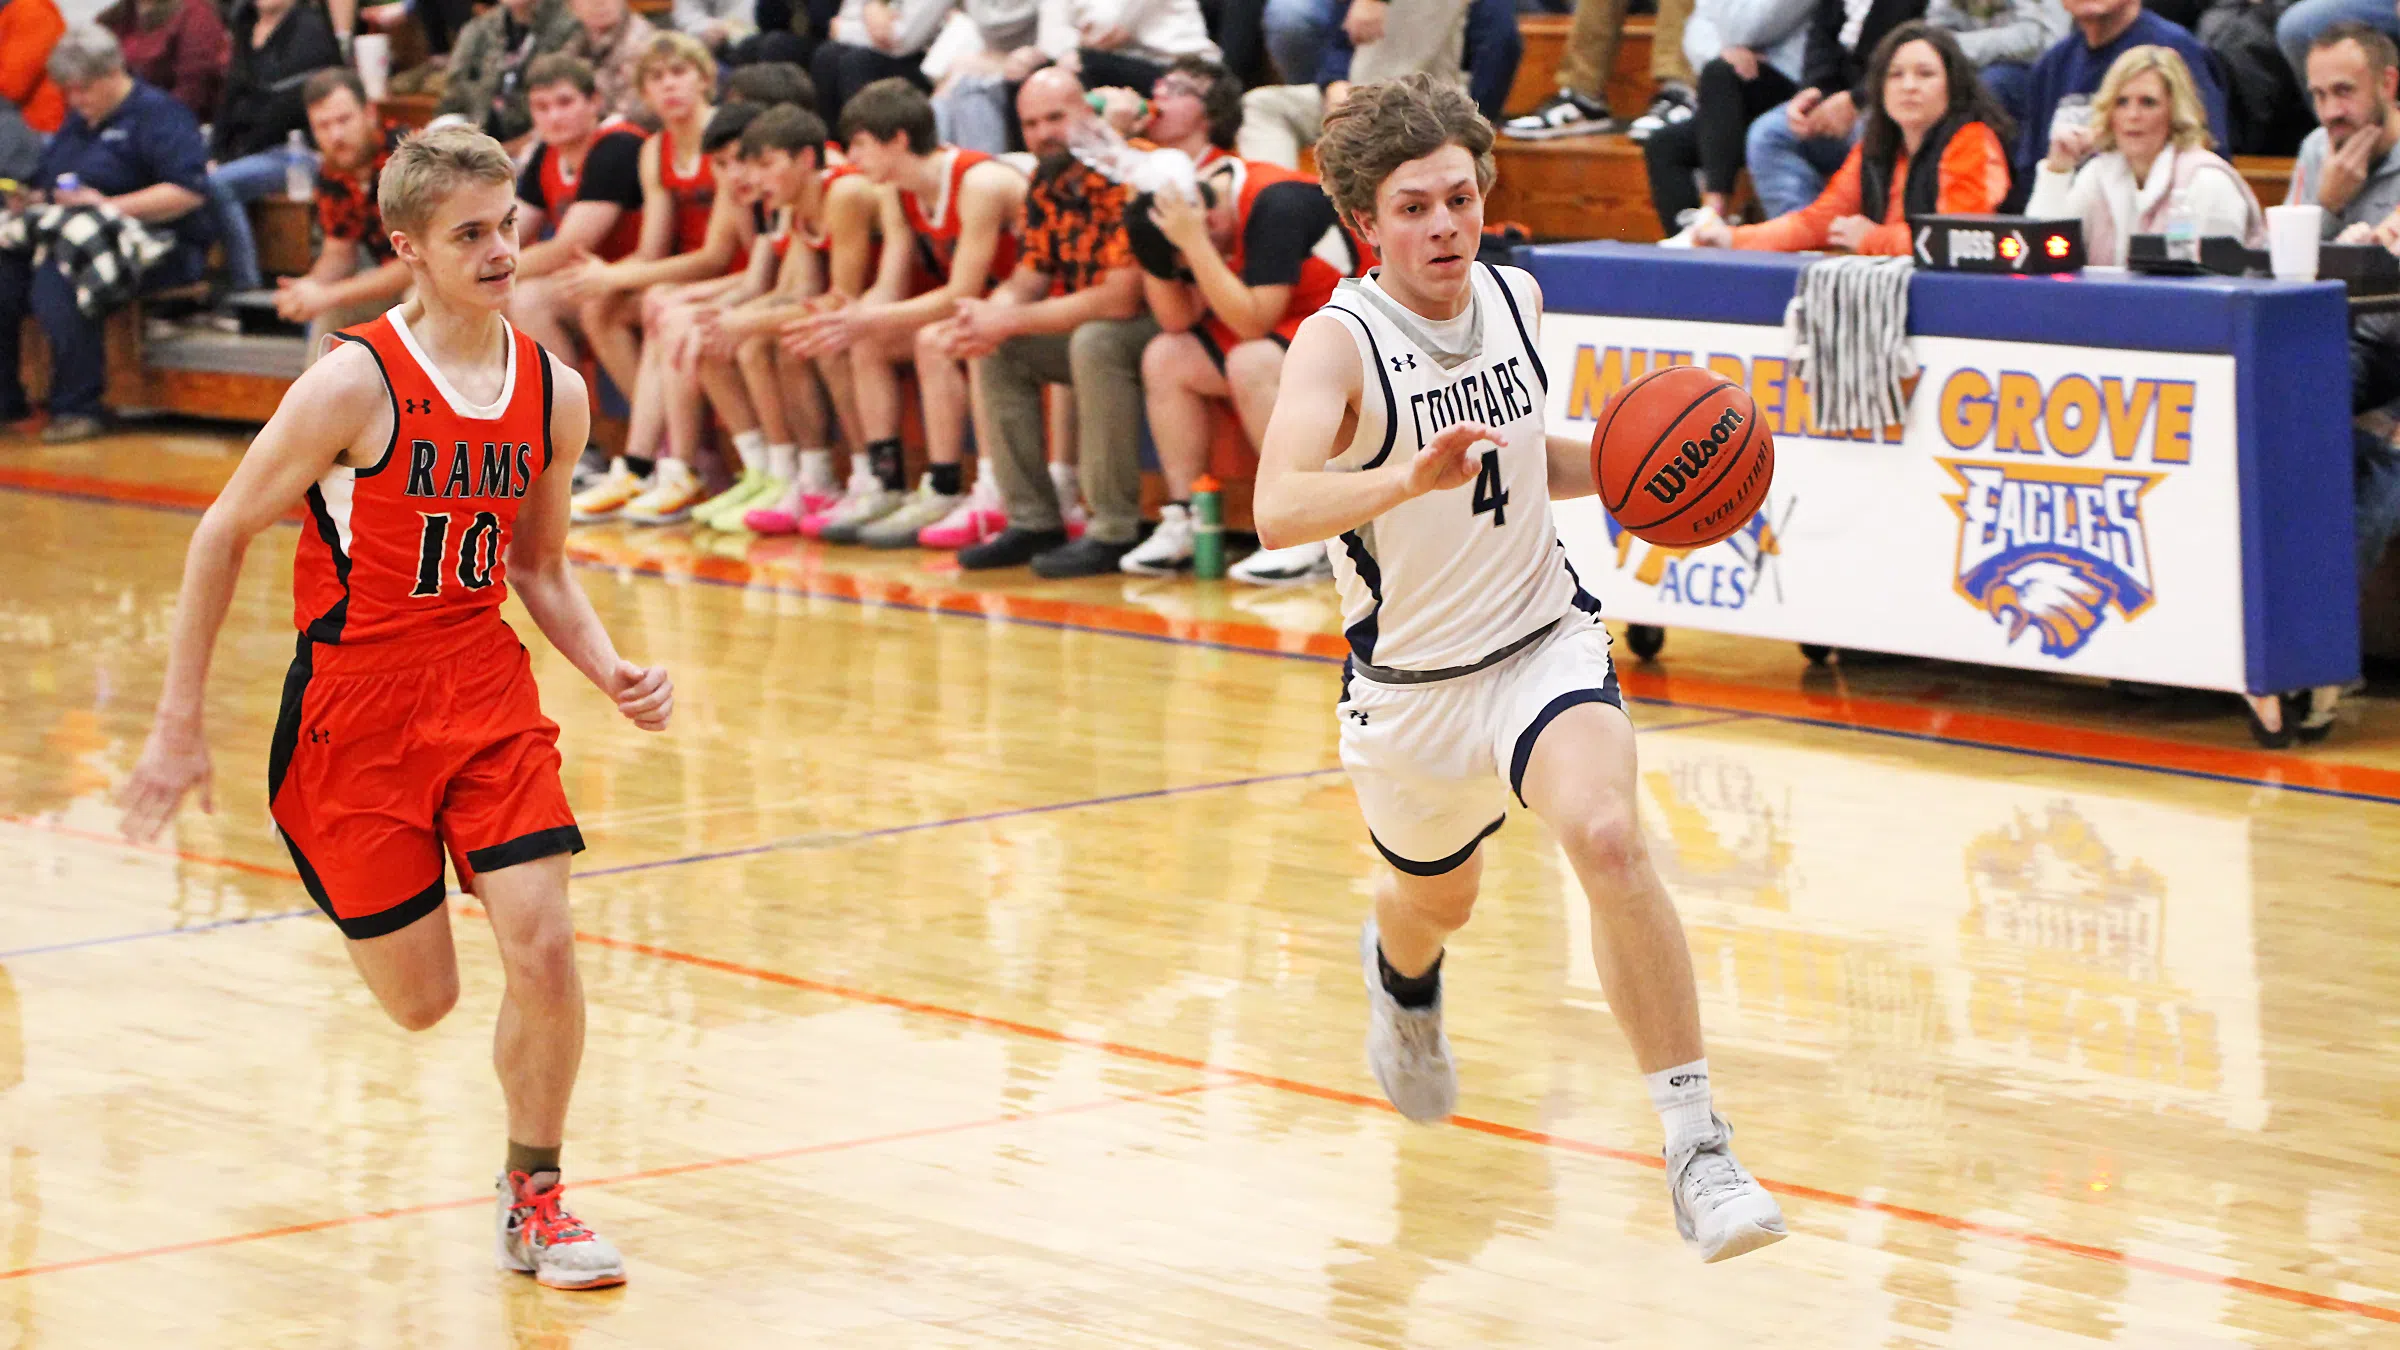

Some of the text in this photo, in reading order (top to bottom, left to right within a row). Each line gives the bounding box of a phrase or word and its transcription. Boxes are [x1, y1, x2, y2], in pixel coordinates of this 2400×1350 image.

[1410, 356, 1533, 452] COUGARS
[1937, 366, 2197, 465] GROVE
[403, 439, 532, 499] RAMS
[1472, 448, 1509, 529] 4
[1643, 406, 1745, 504] Wilson
[1692, 440, 1769, 533] EVOLUTION
[408, 510, 504, 598] 10
[1952, 464, 2154, 594] EAGLES
[1658, 561, 1747, 610] ACES
